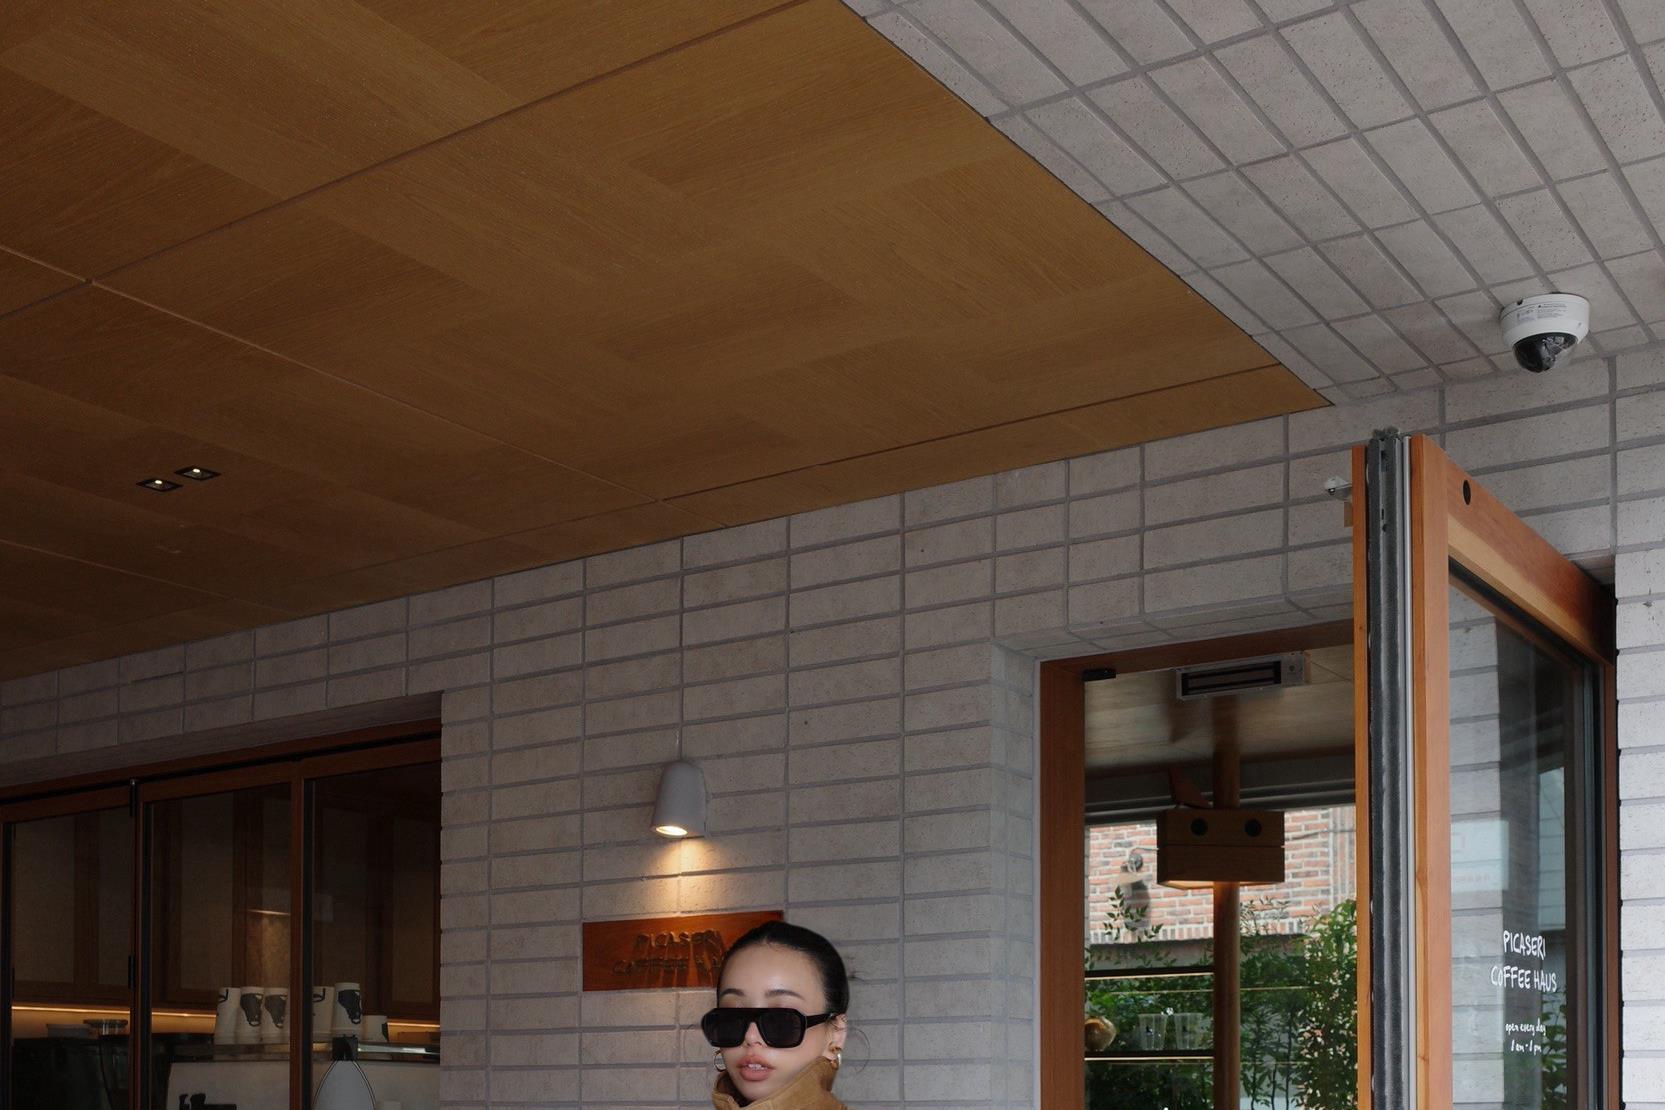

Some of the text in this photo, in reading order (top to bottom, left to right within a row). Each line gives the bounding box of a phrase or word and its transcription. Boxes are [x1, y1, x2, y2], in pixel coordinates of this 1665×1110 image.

[1503, 930, 1546, 960] PICASERI
[1491, 965, 1557, 992] COFFEE HAUS
[1505, 1023, 1519, 1035] open
